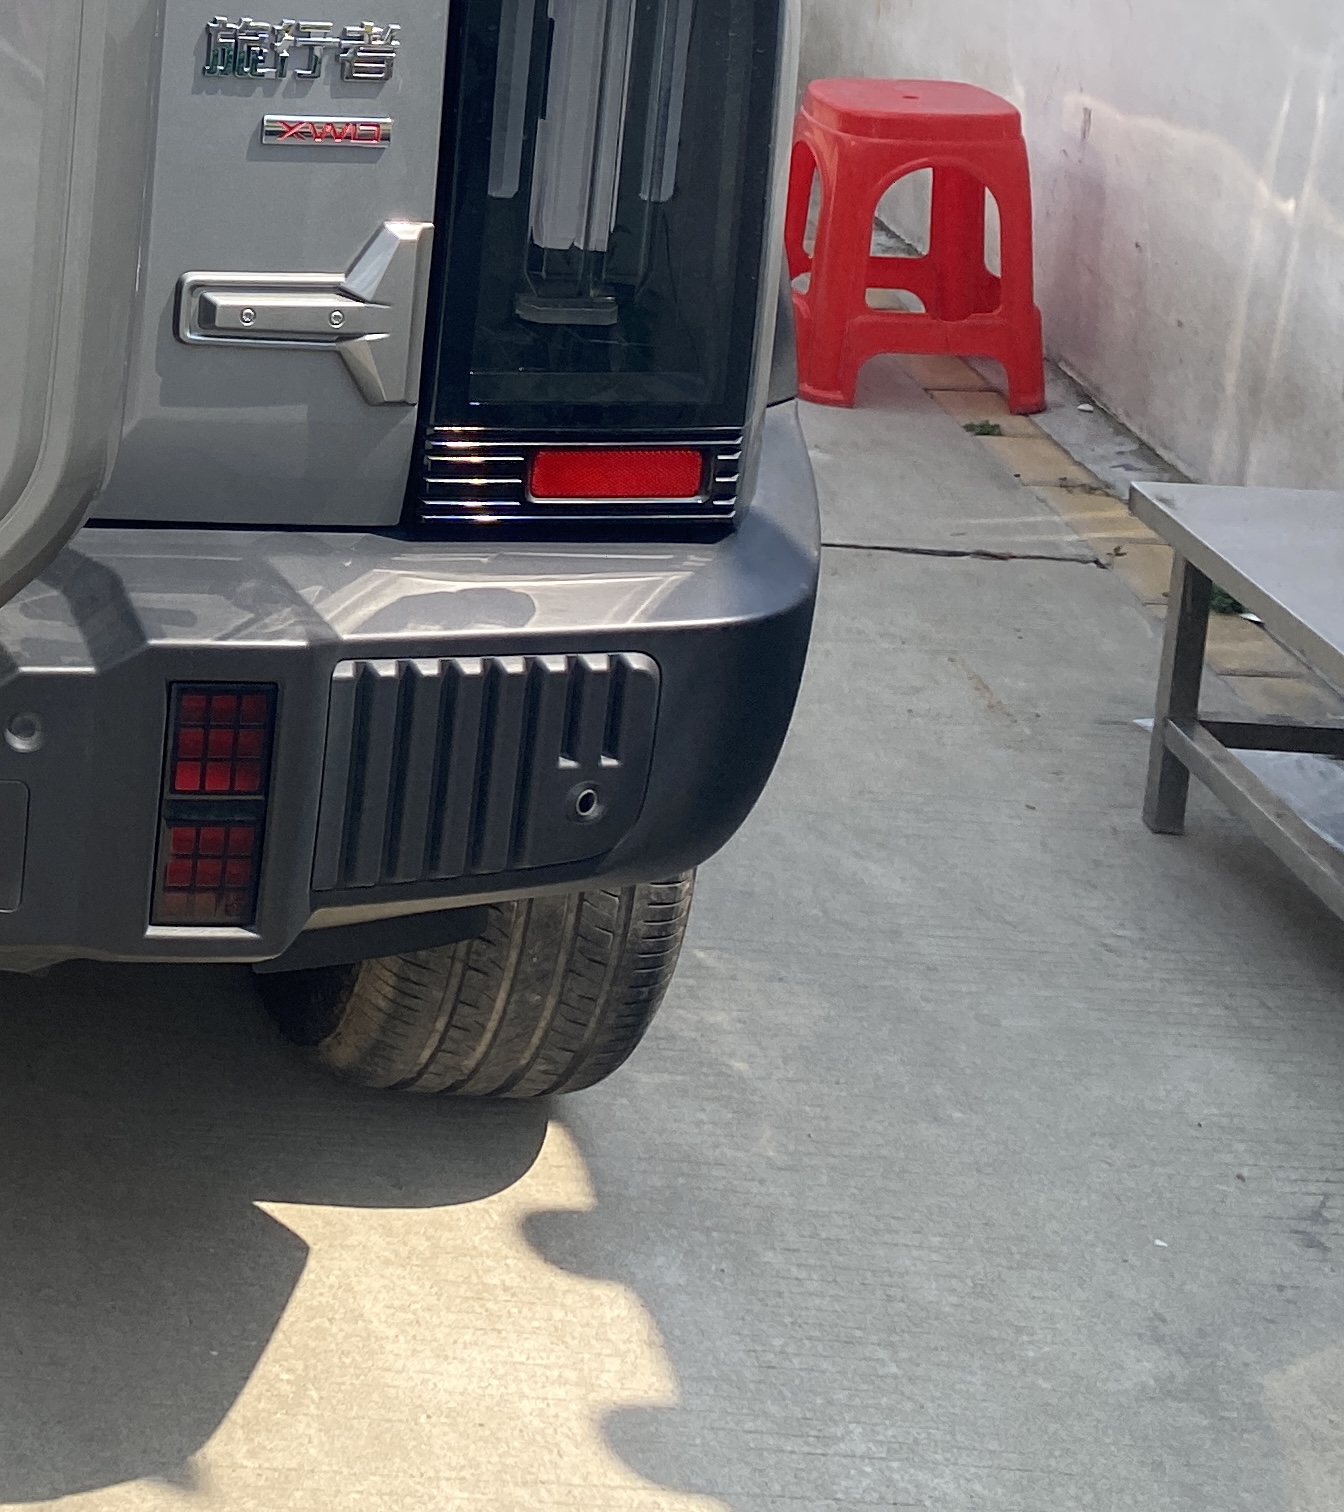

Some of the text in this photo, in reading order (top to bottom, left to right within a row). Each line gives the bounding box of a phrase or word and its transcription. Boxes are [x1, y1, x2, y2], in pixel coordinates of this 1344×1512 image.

[202, 16, 401, 82] 旅行者
[275, 120, 382, 144] XWD
